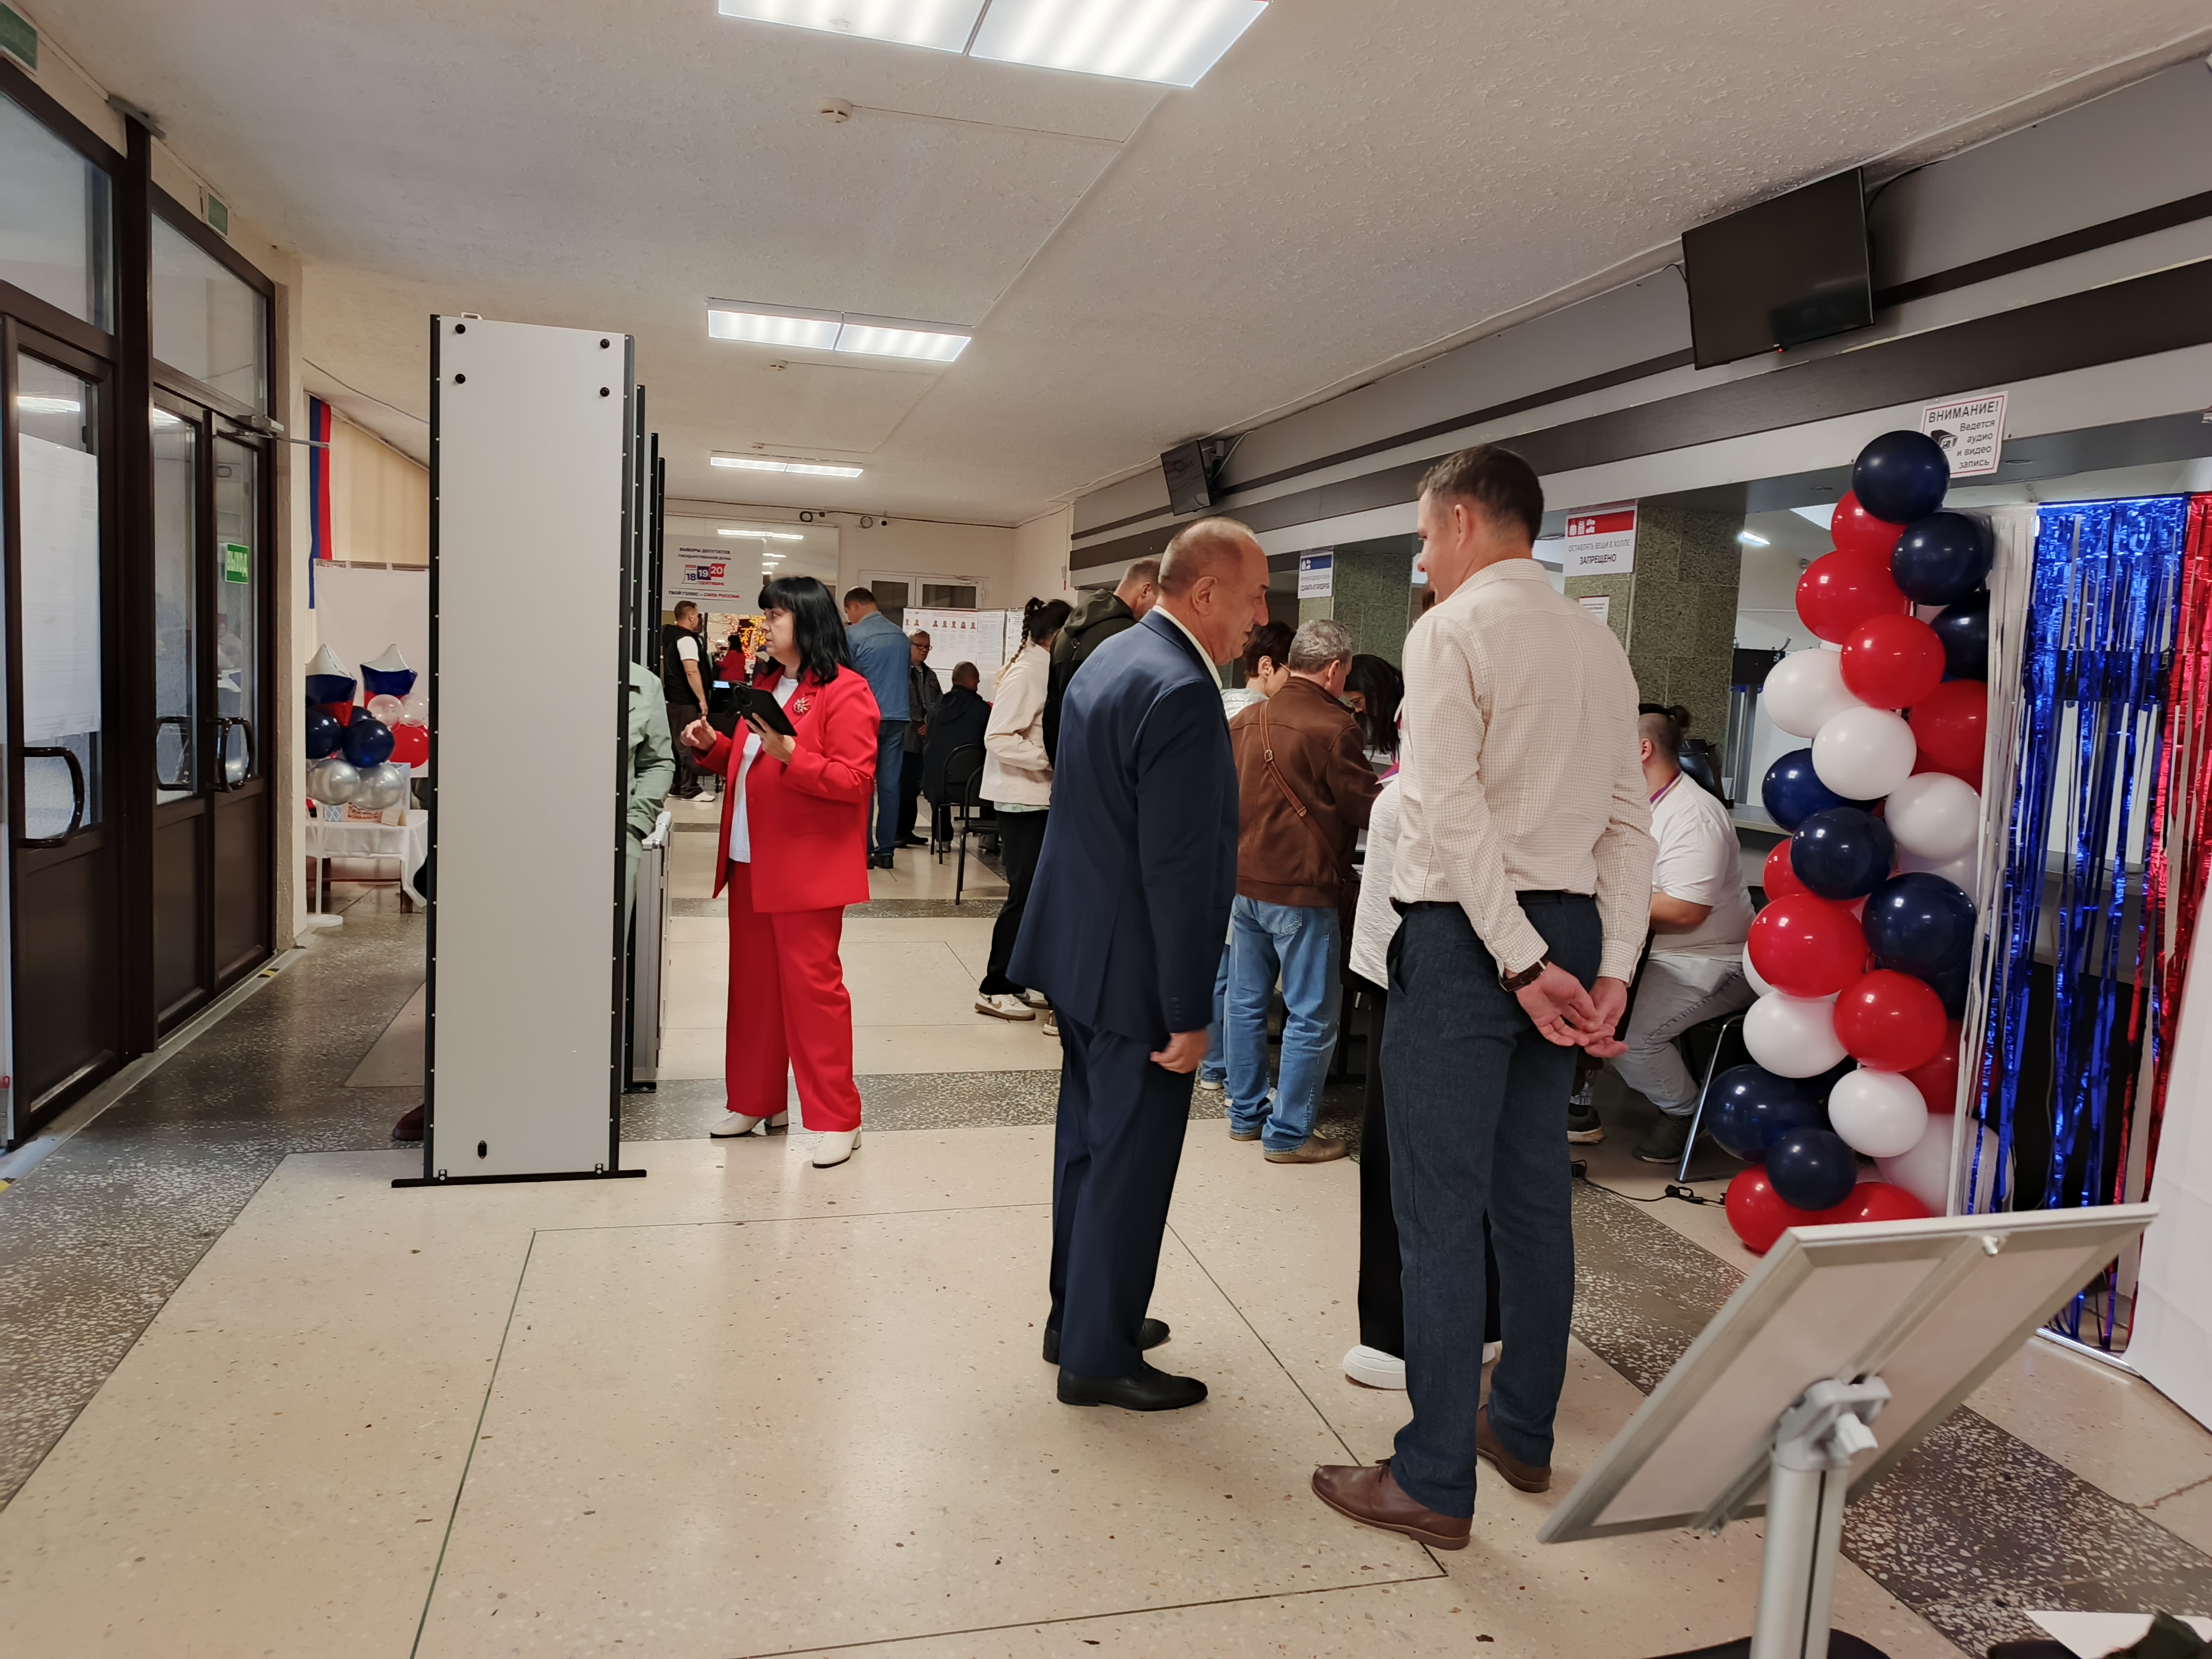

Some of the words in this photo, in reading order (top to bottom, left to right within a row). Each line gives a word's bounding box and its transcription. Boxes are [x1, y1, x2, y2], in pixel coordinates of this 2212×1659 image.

[1928, 400, 1998, 423] ВНИМАНИЕ!
[1959, 419, 1995, 432] Ведется
[1967, 433, 1993, 445] аудио
[1964, 445, 1992, 457] видео
[1958, 459, 1990, 469] запись
[1568, 542, 1594, 552] ОСТАВЛЯТЬ
[227, 550, 248, 578] ВЫХОД
[1579, 554, 1617, 565] ЗАПРЕЩЕНО
[698, 569, 709, 578] 19
